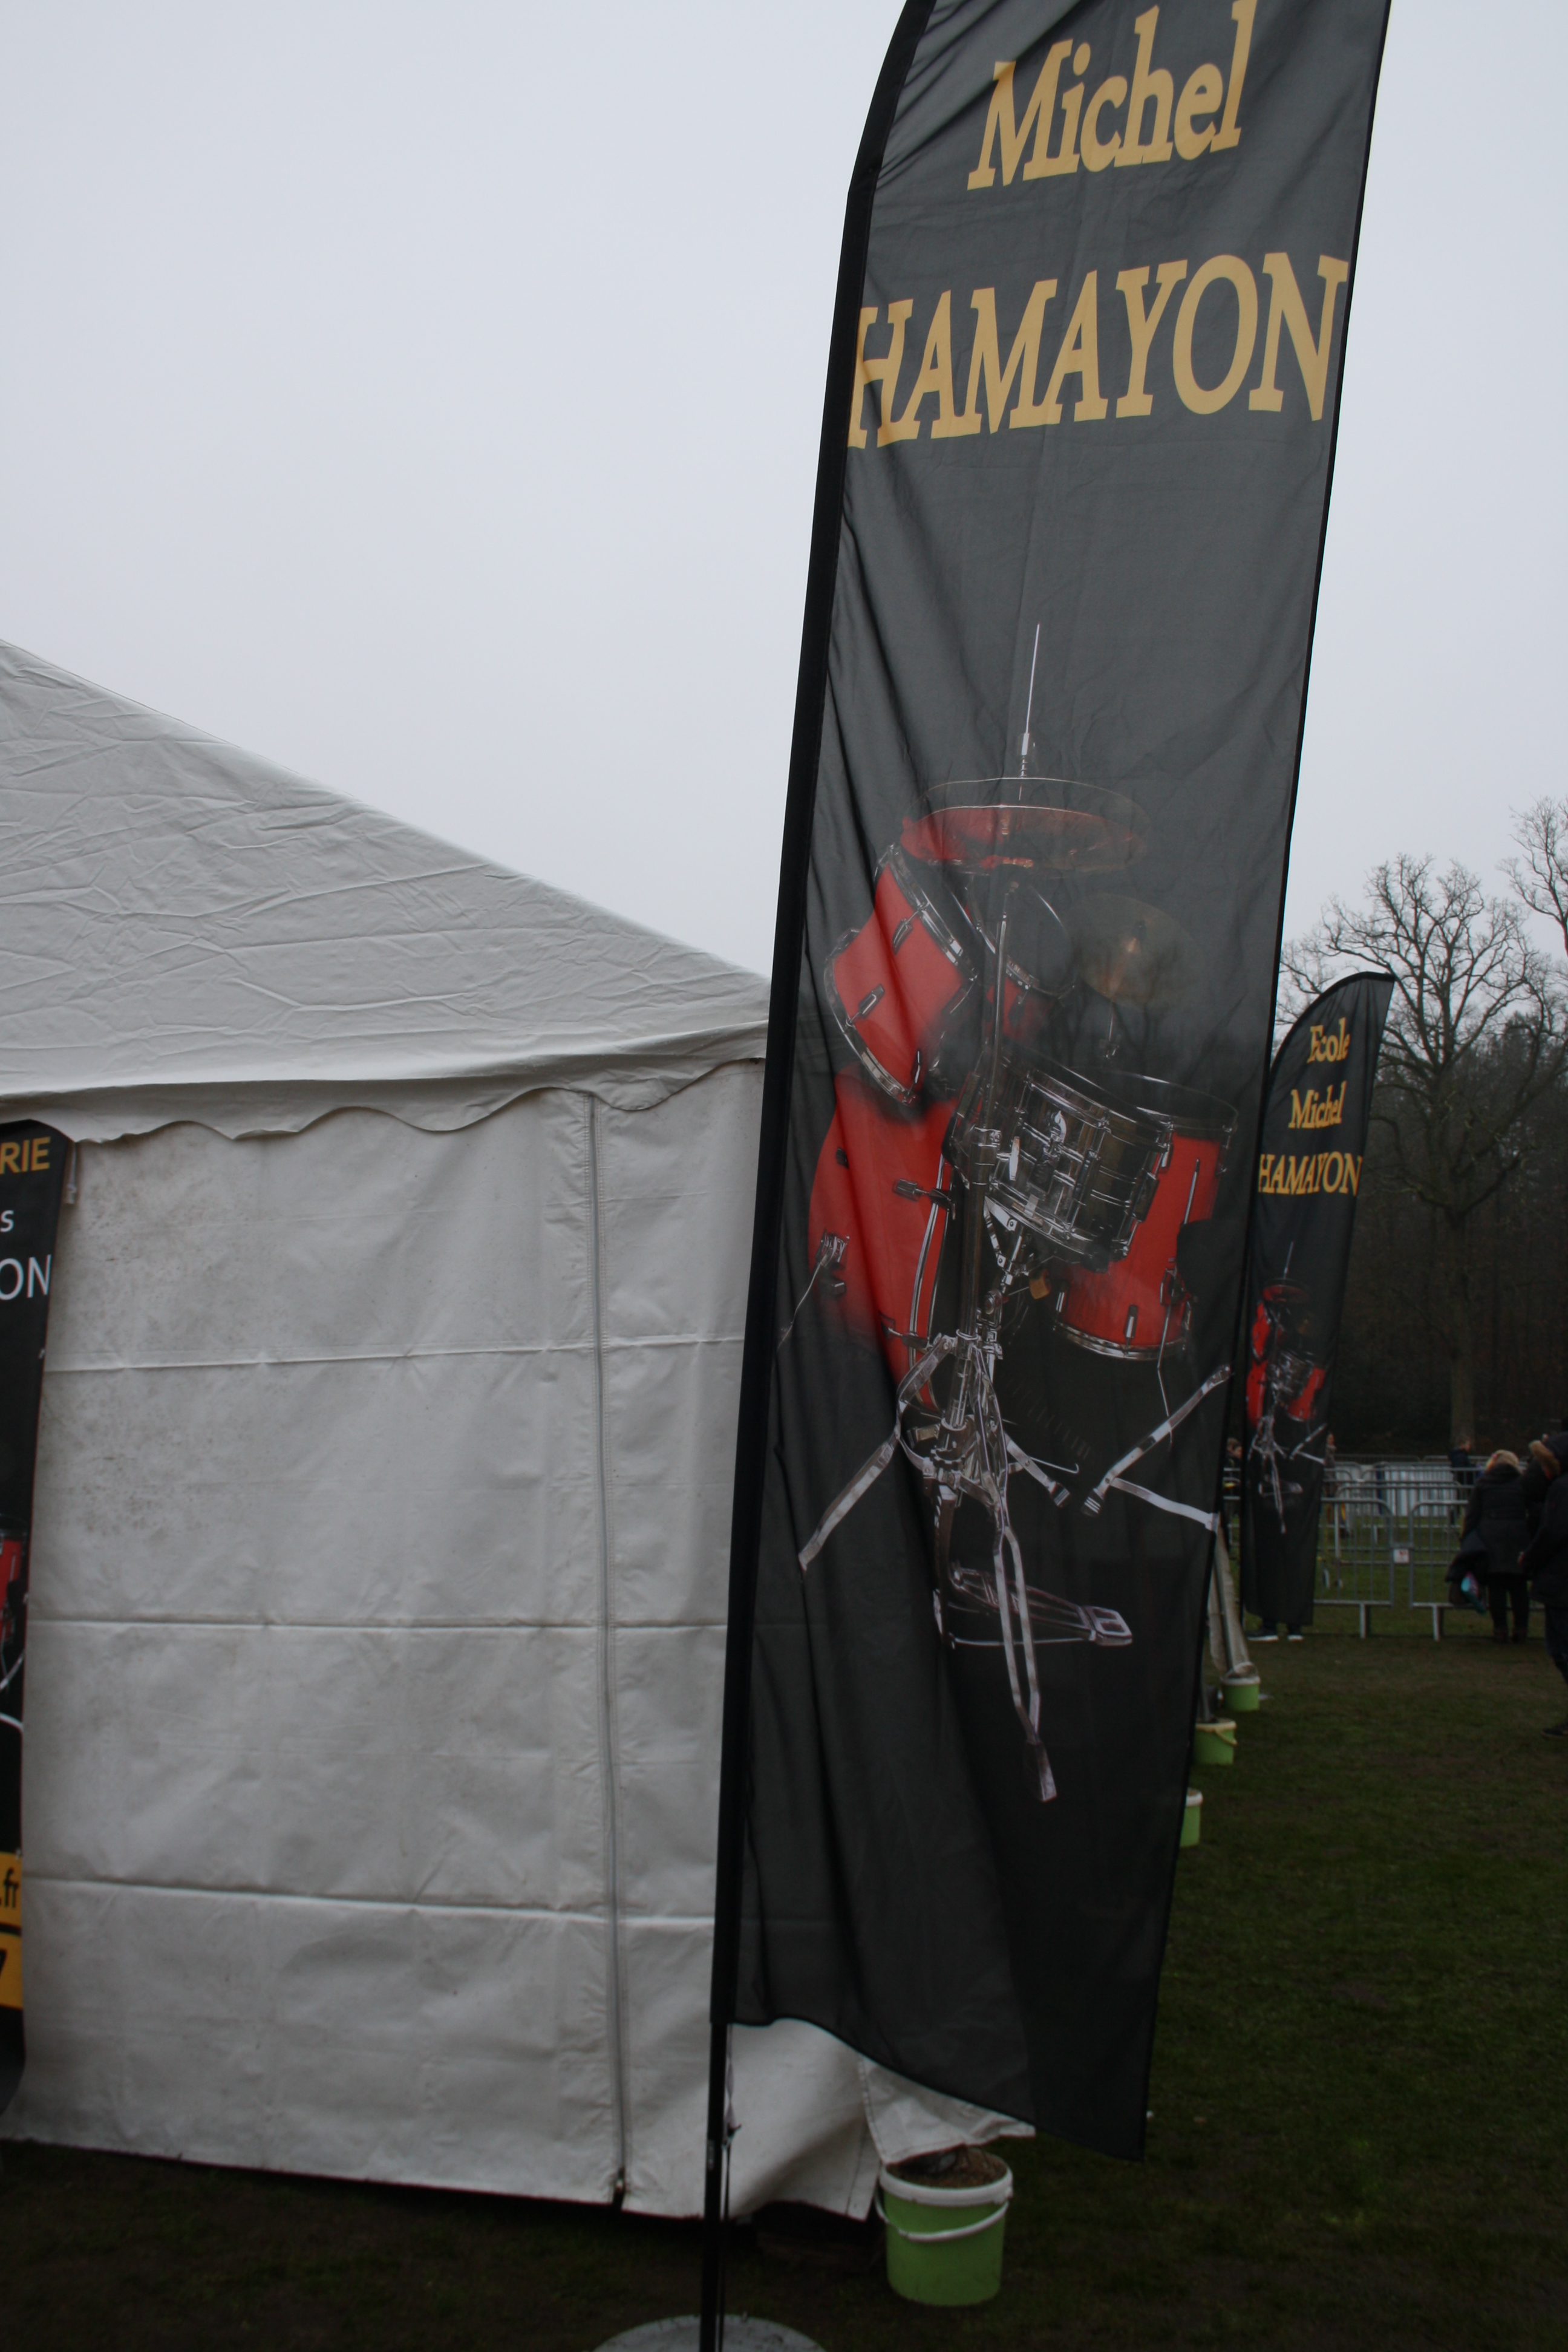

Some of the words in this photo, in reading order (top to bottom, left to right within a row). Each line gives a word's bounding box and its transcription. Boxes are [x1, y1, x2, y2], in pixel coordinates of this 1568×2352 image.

[968, 0, 1256, 190] Michel
[848, 253, 1348, 449] HAMAYON
[1307, 1018, 1351, 1063] Ecole
[1289, 1080, 1347, 1129] Michel
[1258, 1151, 1363, 1196] HAMAYON
